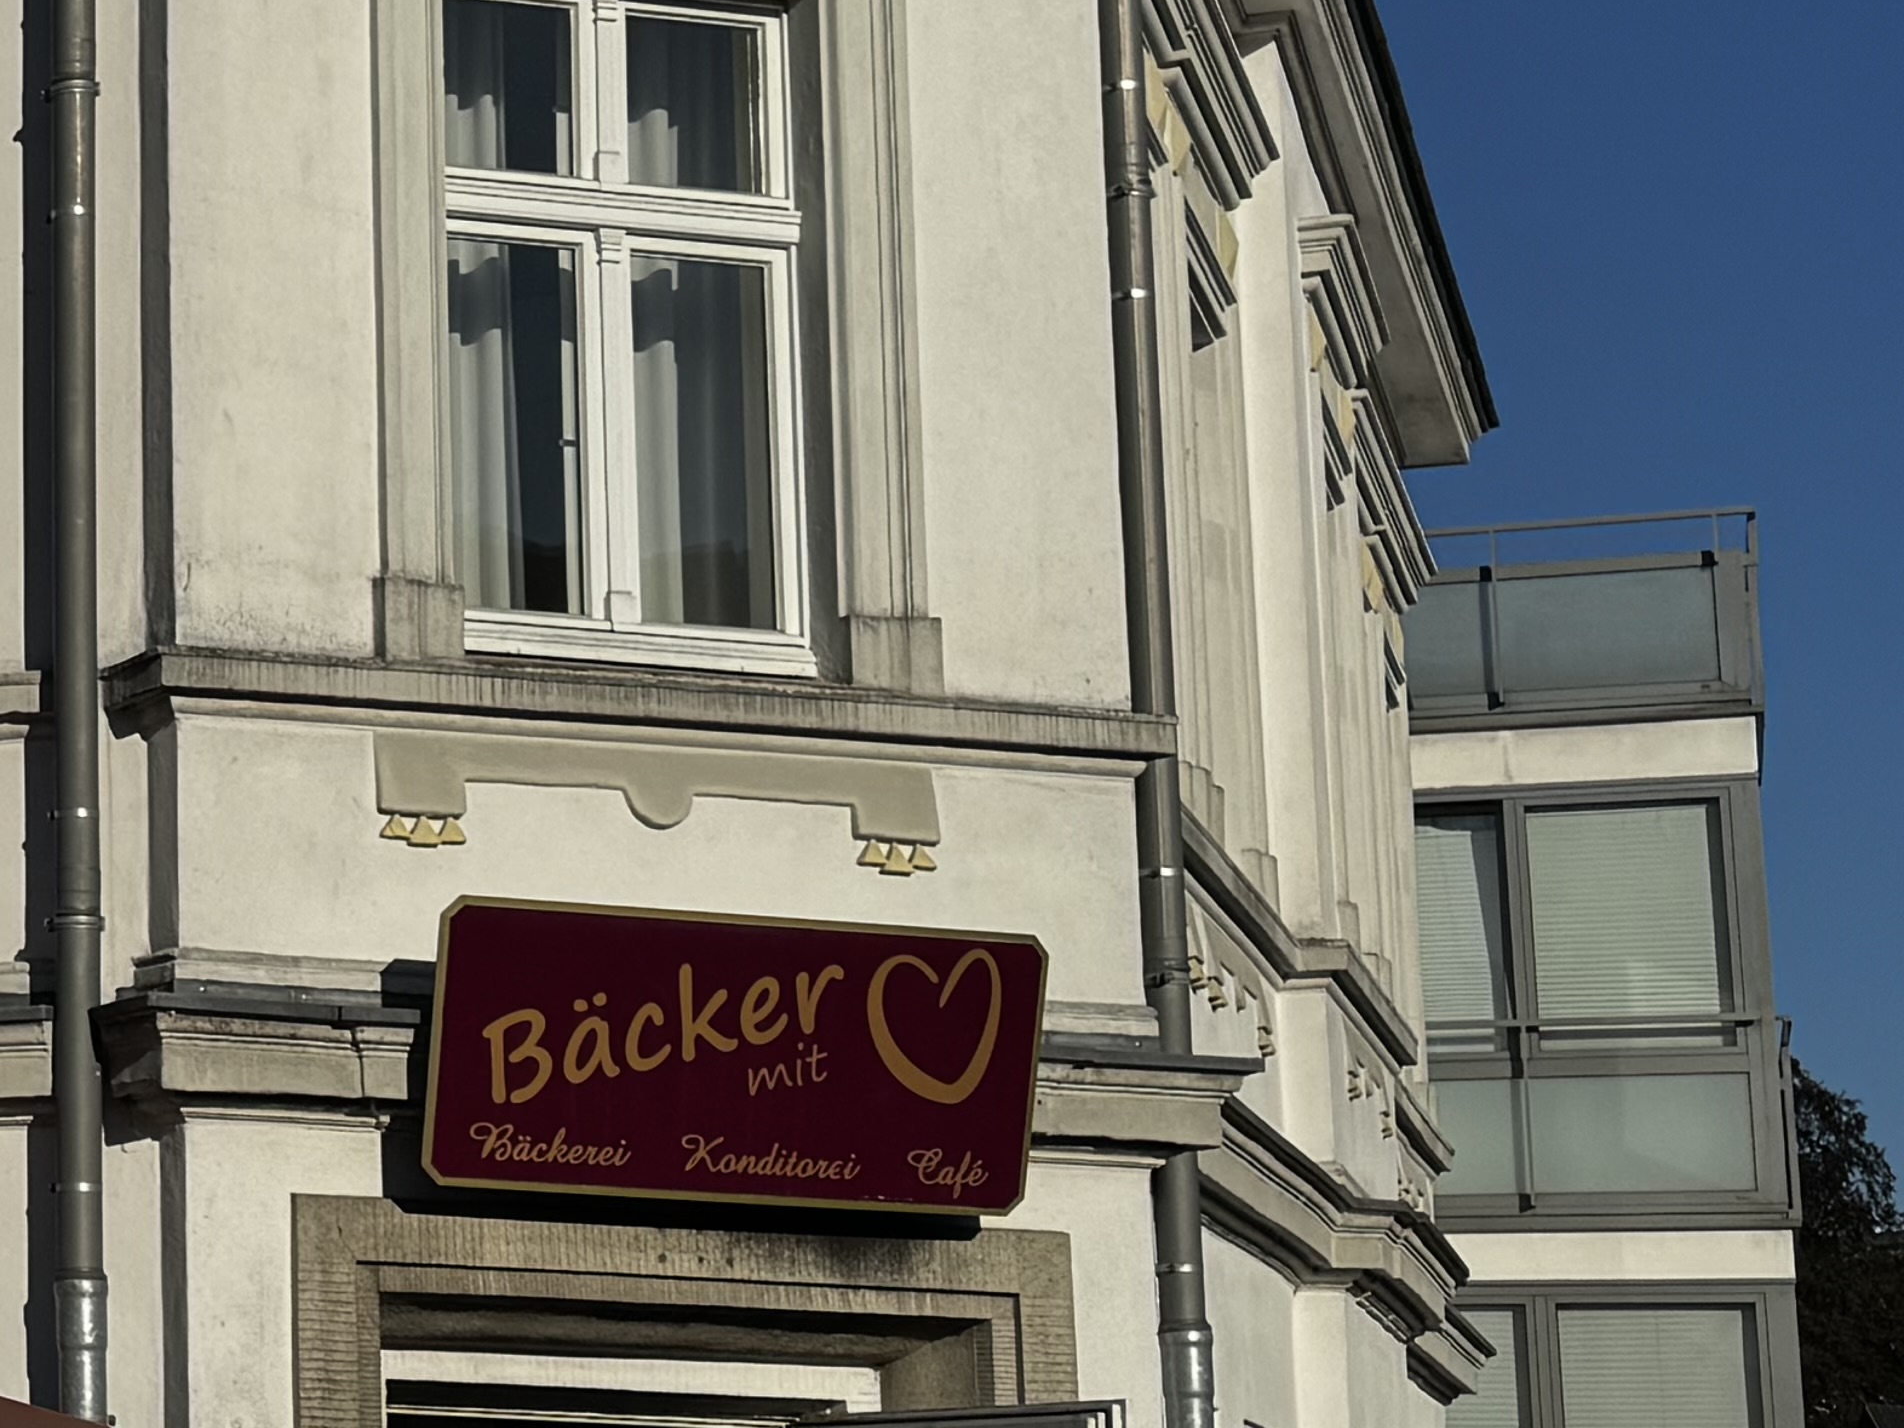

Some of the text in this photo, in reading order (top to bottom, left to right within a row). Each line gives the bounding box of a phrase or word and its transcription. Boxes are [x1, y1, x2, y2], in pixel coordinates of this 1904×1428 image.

[482, 963, 845, 1105] Bäcker
[747, 1042, 829, 1097] mit
[469, 1121, 990, 1199] Bäckerei Konditorei Café
